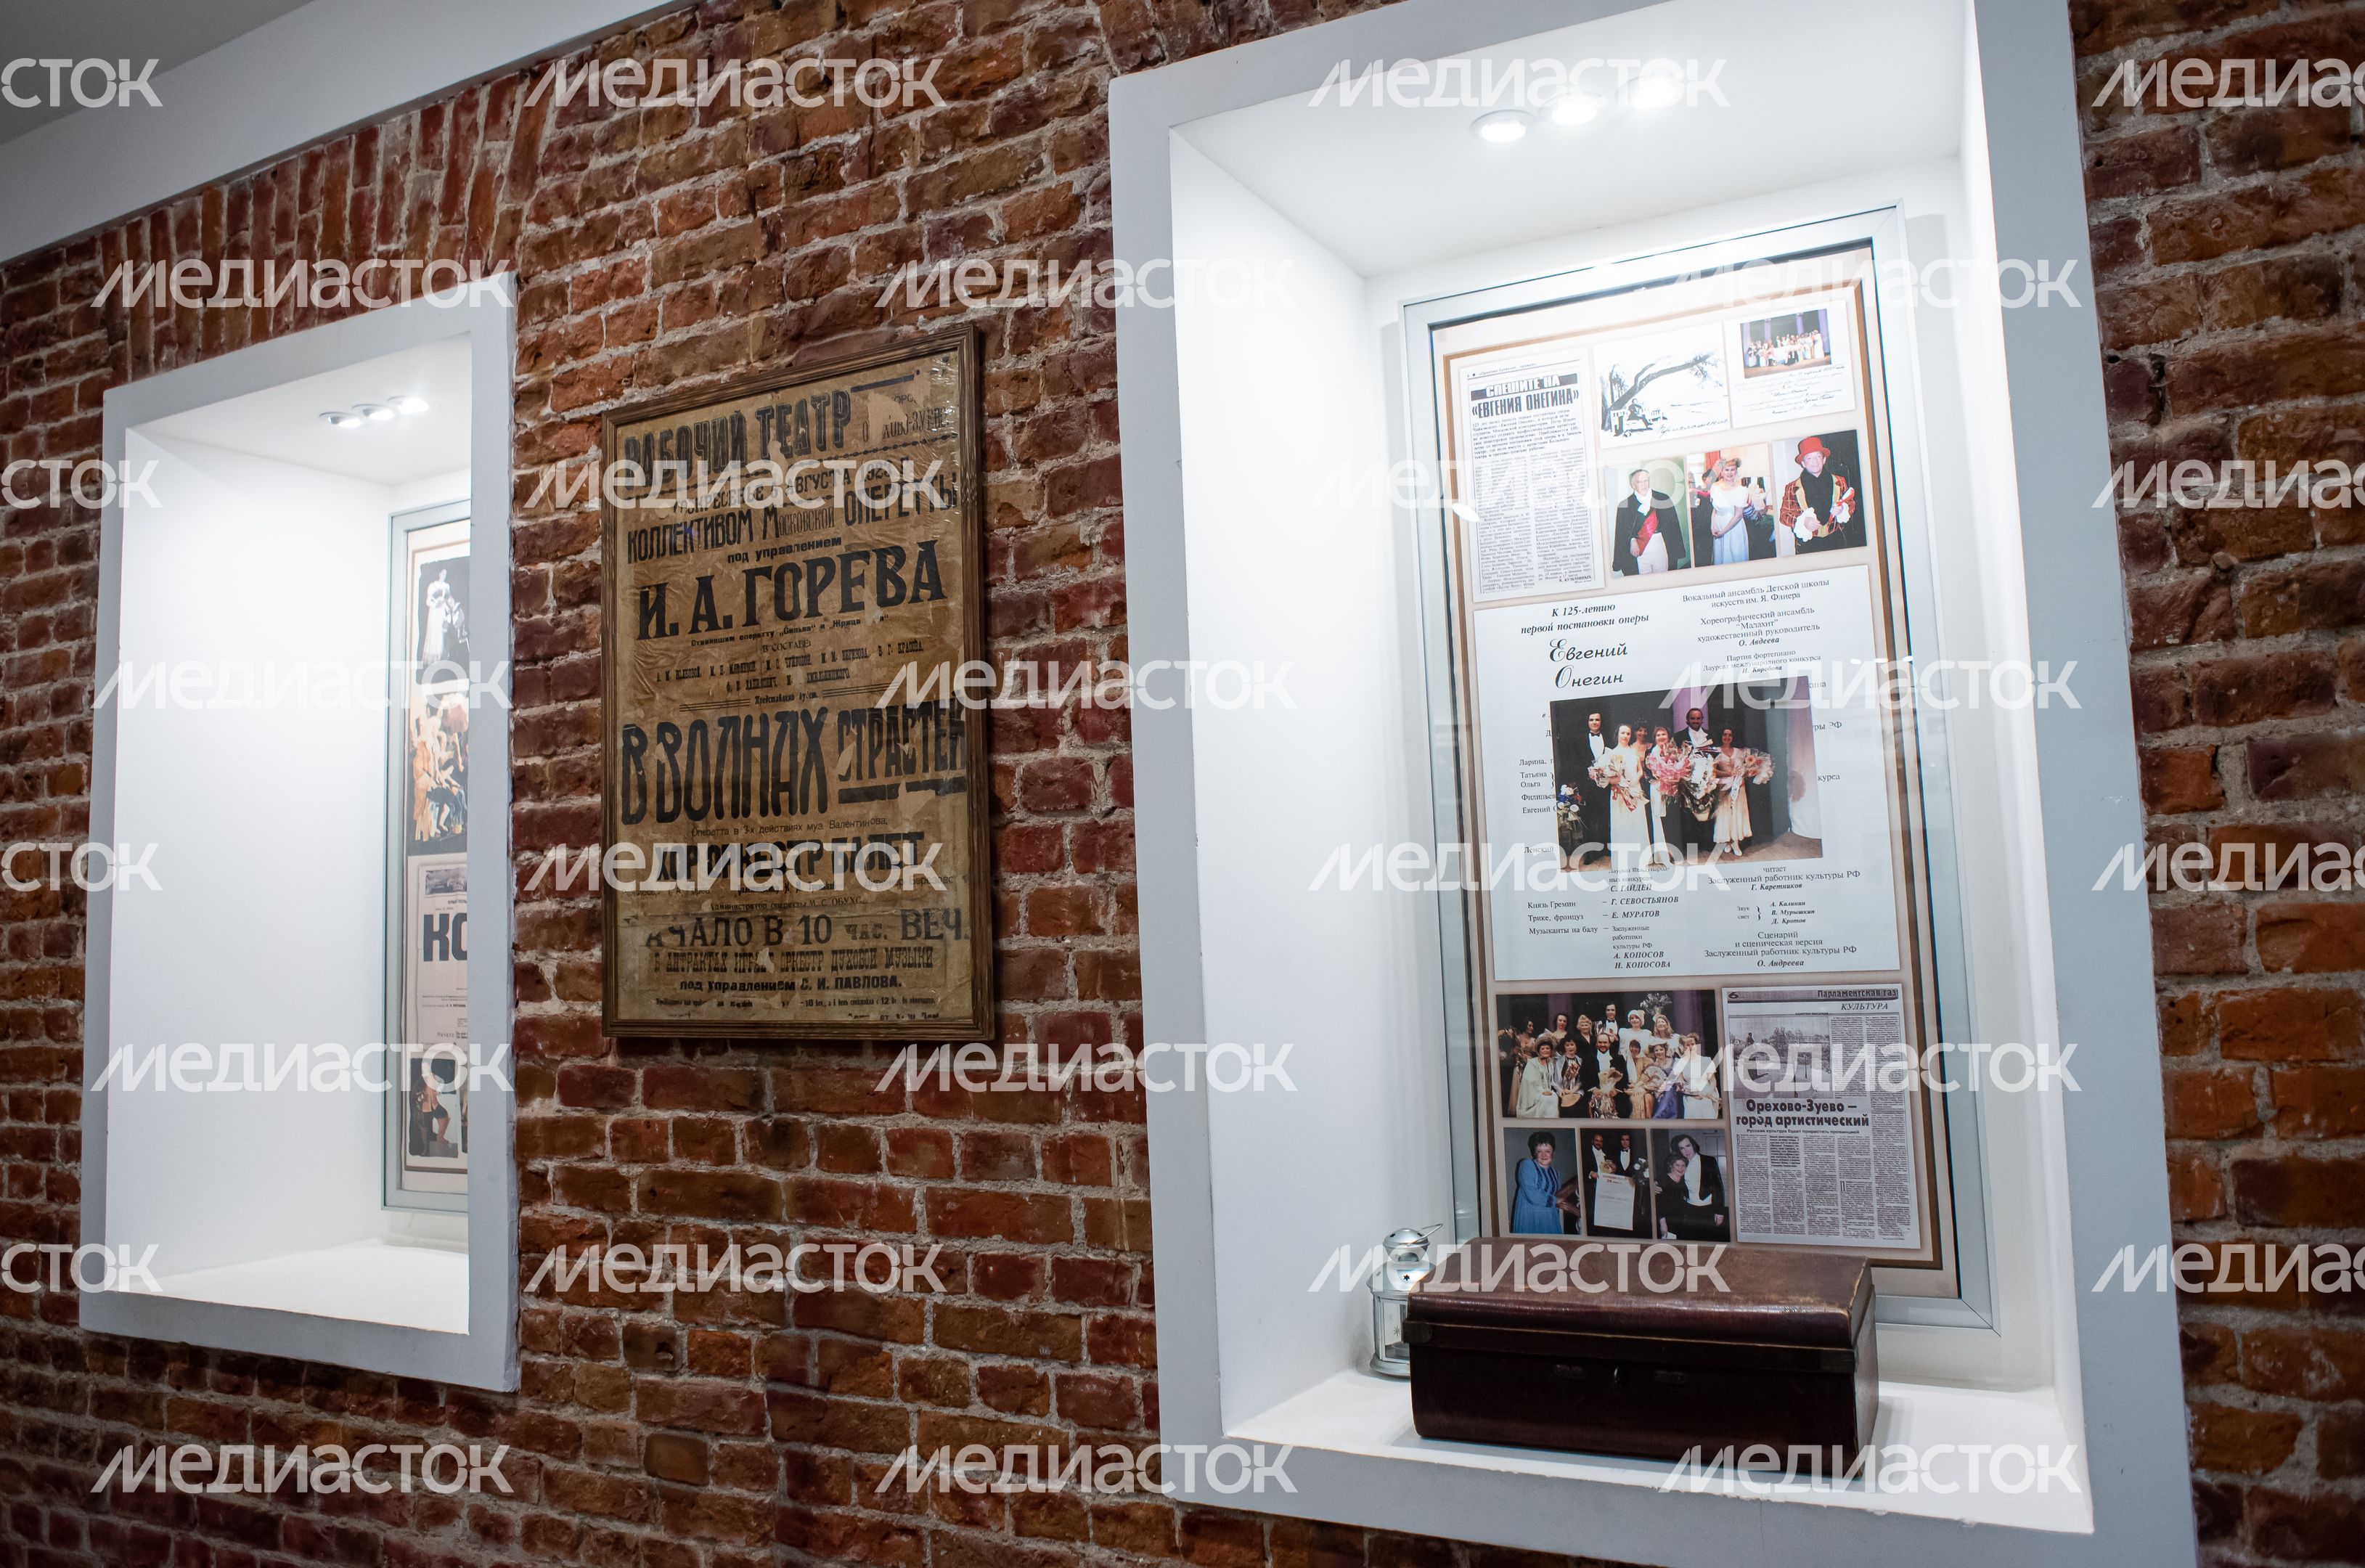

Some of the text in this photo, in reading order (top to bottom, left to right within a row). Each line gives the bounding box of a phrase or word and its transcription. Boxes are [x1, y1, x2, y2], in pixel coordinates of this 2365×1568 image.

[1485, 374, 1561, 397] СПЕШИТЕ НА
[1472, 388, 1580, 418] «ЕВГЕНИЯ ОНЕГИНА»
[624, 390, 850, 491] РАБОЧИЙ ТЕАТР
[628, 473, 957, 563] КОЛЛЕКТИВОМ ОПЕРЕТТЫ
[727, 538, 842, 564] под управлением
[637, 539, 949, 640] И. А. ГОРЕВА
[1683, 580, 1829, 603] Вокальный ансамбль Детской школы
[1711, 599, 1744, 608] искусств
[1770, 592, 1801, 602] Флиера
[1552, 604, 1616, 617] К 125-летию
[1699, 606, 1815, 626] Хореографический ансамбль
[1521, 615, 1649, 636] первой постановки оперы
[1696, 624, 1821, 642] художественный руководитель
[1749, 637, 1780, 646] Авдеева
[1549, 638, 1627, 662] Евгений
[1753, 650, 1796, 660] фортепиано
[1789, 655, 1821, 663] конкурса
[1555, 665, 1624, 689] Онегин
[621, 724, 648, 825] В
[655, 706, 828, 823] ВОЛНАХ
[1817, 773, 1840, 783] курса
[759, 822, 803, 835] действиях
[806, 822, 825, 833] муз.
[1524, 846, 1554, 854] Ленский
[655, 844, 698, 883] ХОР
[706, 840, 824, 879] ОРКЕСТР
[1707, 870, 1860, 886] Заслуженный работник культуры РФ
[1620, 883, 1653, 893] ГАЙДЕЙ
[1760, 883, 1802, 891] Каретников
[1619, 897, 1679, 905] СЕВОСТЬЯНОВ
[763, 908, 970, 947] В 10 ВЕЧ.
[1757, 931, 1799, 940] Сценарий
[1704, 949, 1758, 958] Заслуженный
[1760, 947, 1800, 957] работник
[1802, 947, 1840, 956] культуры
[1742, 940, 1793, 949] сценическая
[666, 952, 728, 973] АНТРАКТАХ
[885, 946, 934, 969] МУЗЫКИ
[1625, 960, 1671, 969] КОПОСОВА
[1768, 959, 1804, 968] Андреева
[679, 979, 703, 992] под
[800, 976, 812, 989] С.
[817, 976, 830, 989] И.
[835, 973, 902, 989] ПАВЛОВА.
[1817, 989, 1881, 999] Парламентская
[1840, 1002, 1889, 1011] КУЛЬТУРА
[1746, 1098, 1845, 1115] Орехово-Зуево
[1736, 1114, 1869, 1128] город артистический
